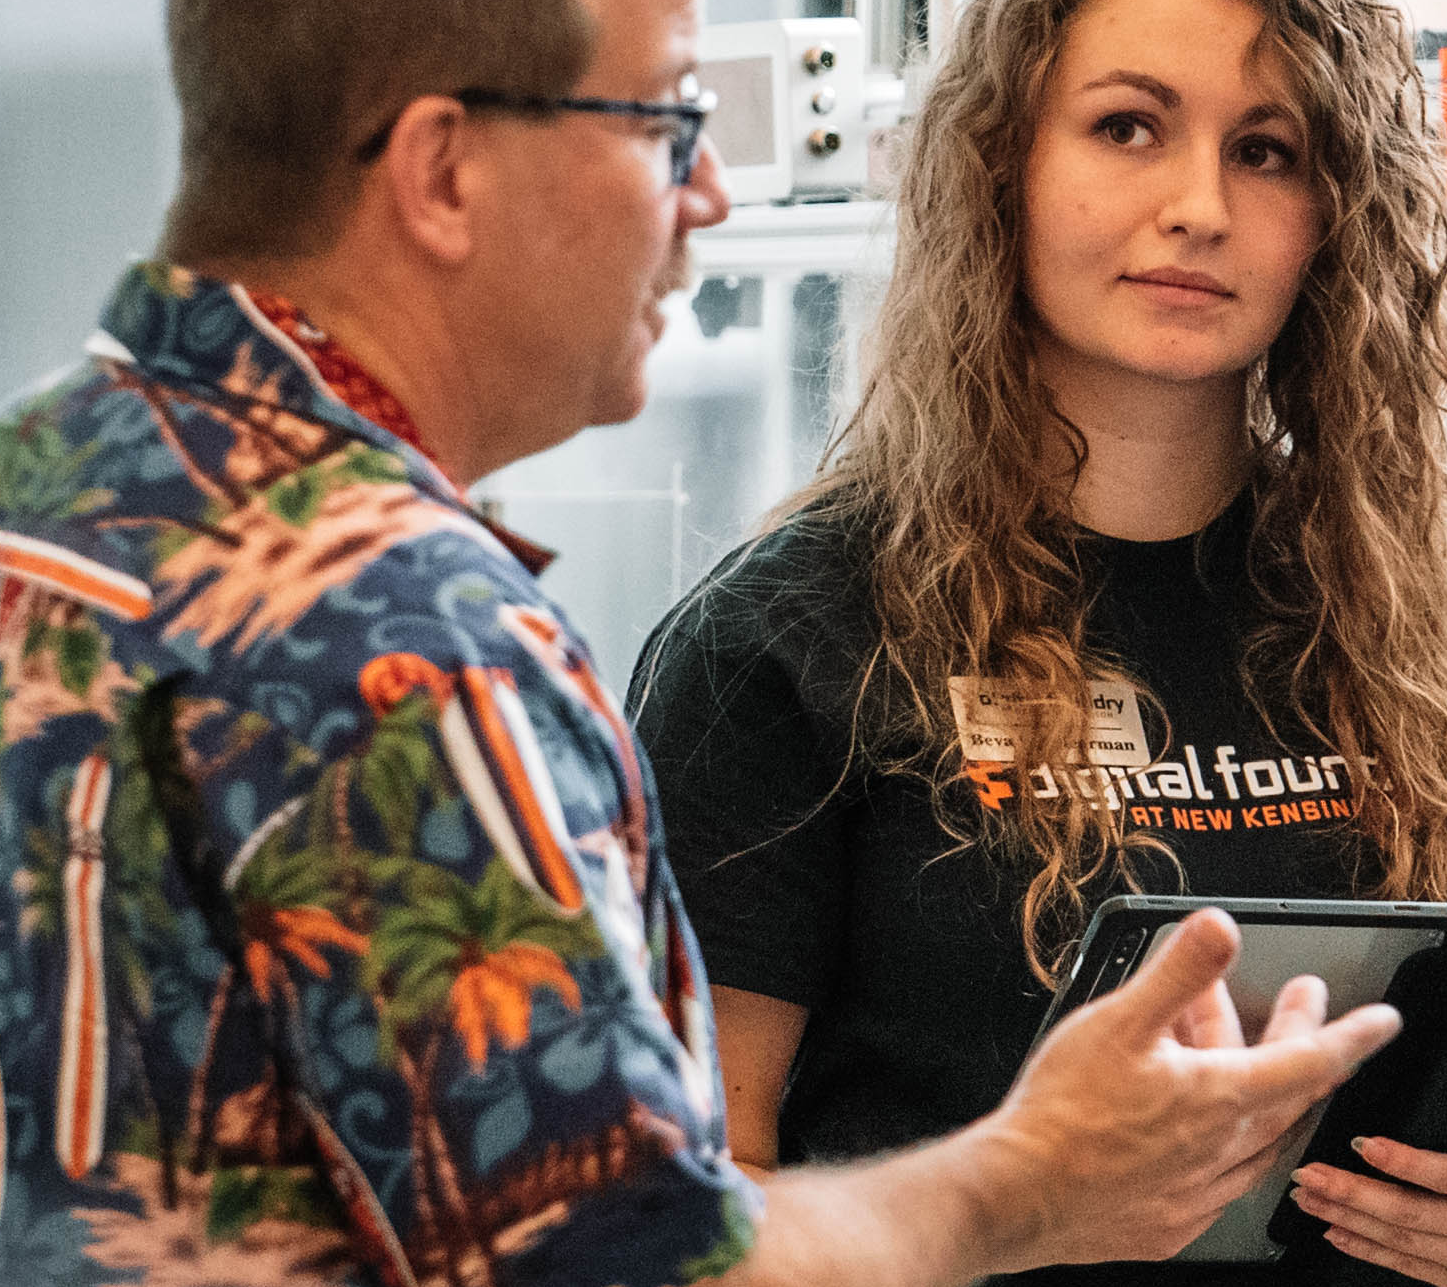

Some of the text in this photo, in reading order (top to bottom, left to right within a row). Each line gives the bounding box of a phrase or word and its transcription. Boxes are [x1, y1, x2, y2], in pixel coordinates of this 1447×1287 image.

[1131, 797, 1354, 832] AT NEW KENSIN
